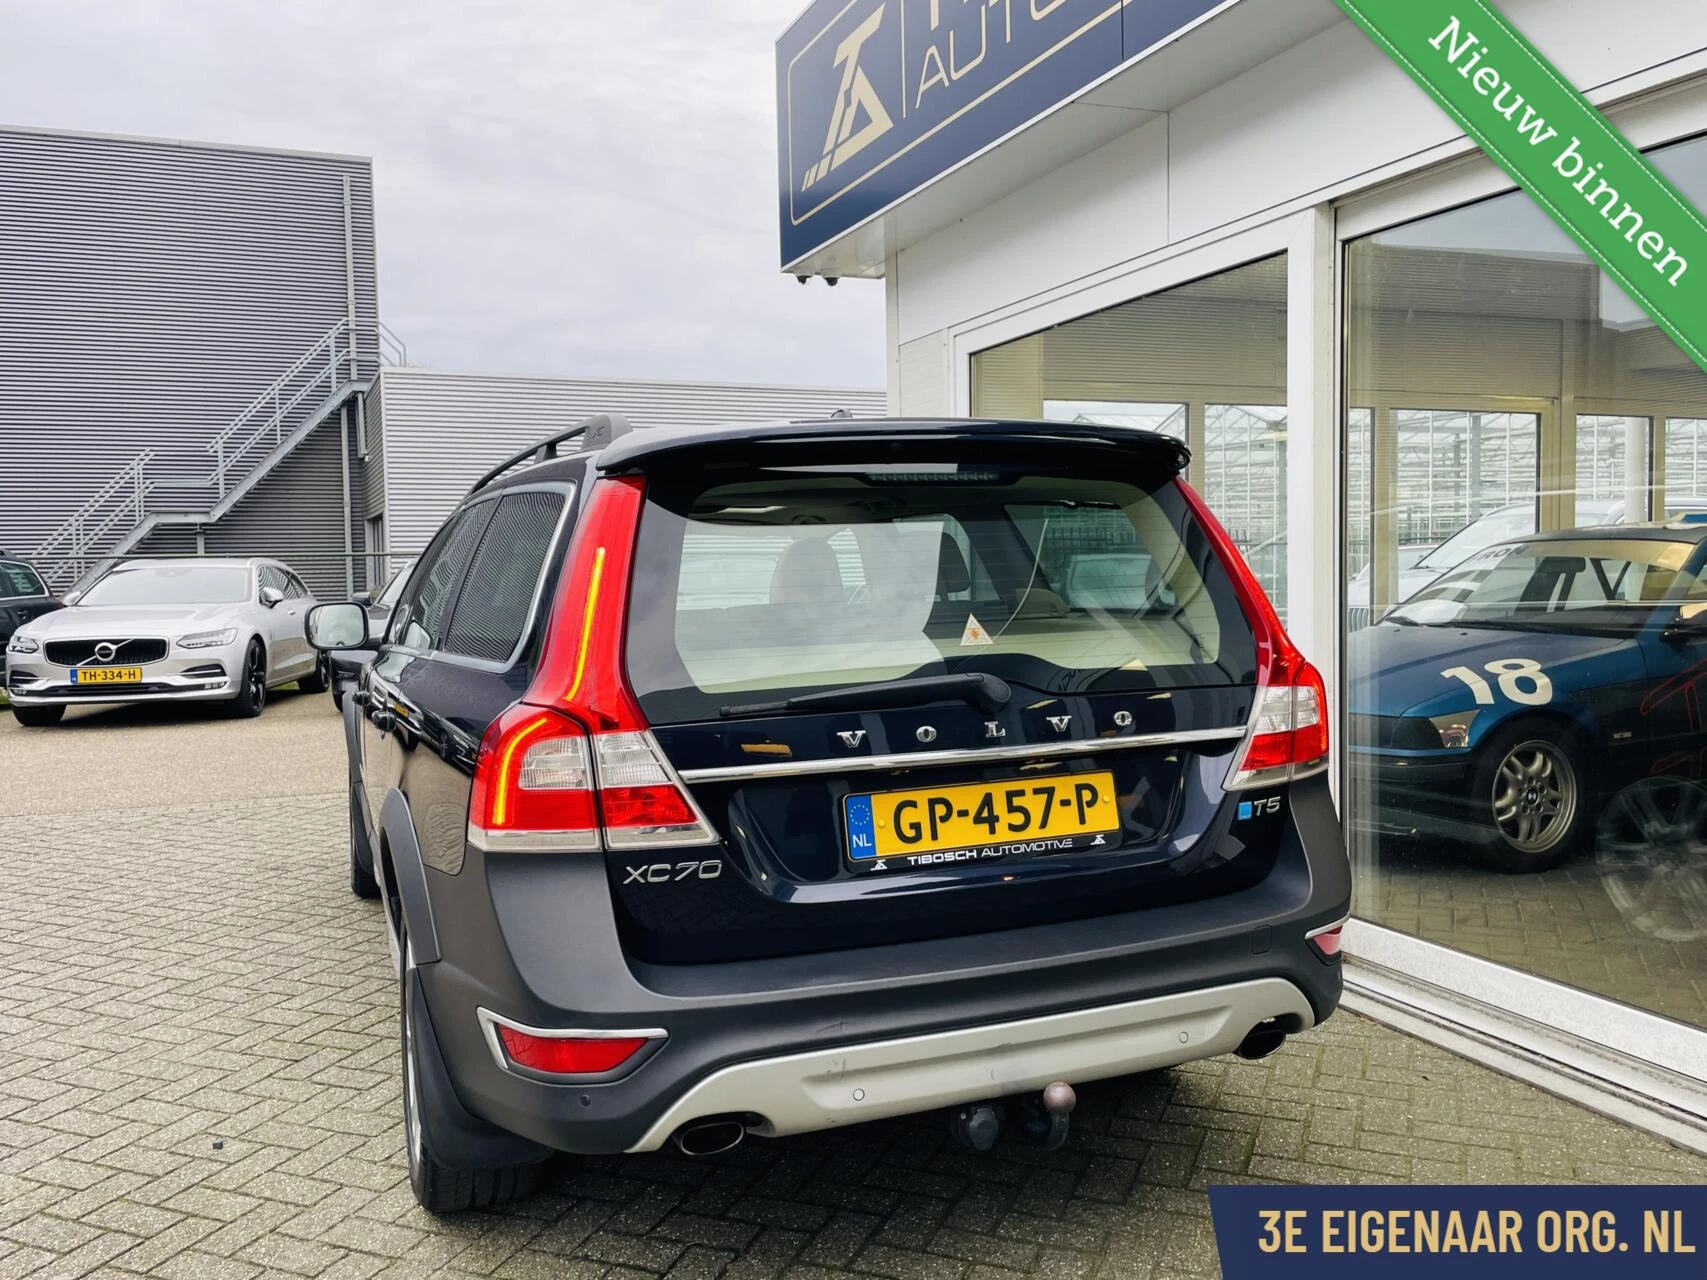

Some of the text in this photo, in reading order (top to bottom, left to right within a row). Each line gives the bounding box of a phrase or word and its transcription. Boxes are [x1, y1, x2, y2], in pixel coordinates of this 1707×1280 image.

[81, 669, 137, 681] TH-334-H
[1441, 658, 1553, 706] 18
[836, 710, 1133, 749] VOLVO
[893, 782, 1099, 844] GP-457-P
[1253, 796, 1281, 816] T5
[852, 834, 872, 848] NL
[907, 838, 1073, 866] TIBOSCH AUTOMOTIVE
[623, 860, 722, 885] XC70
